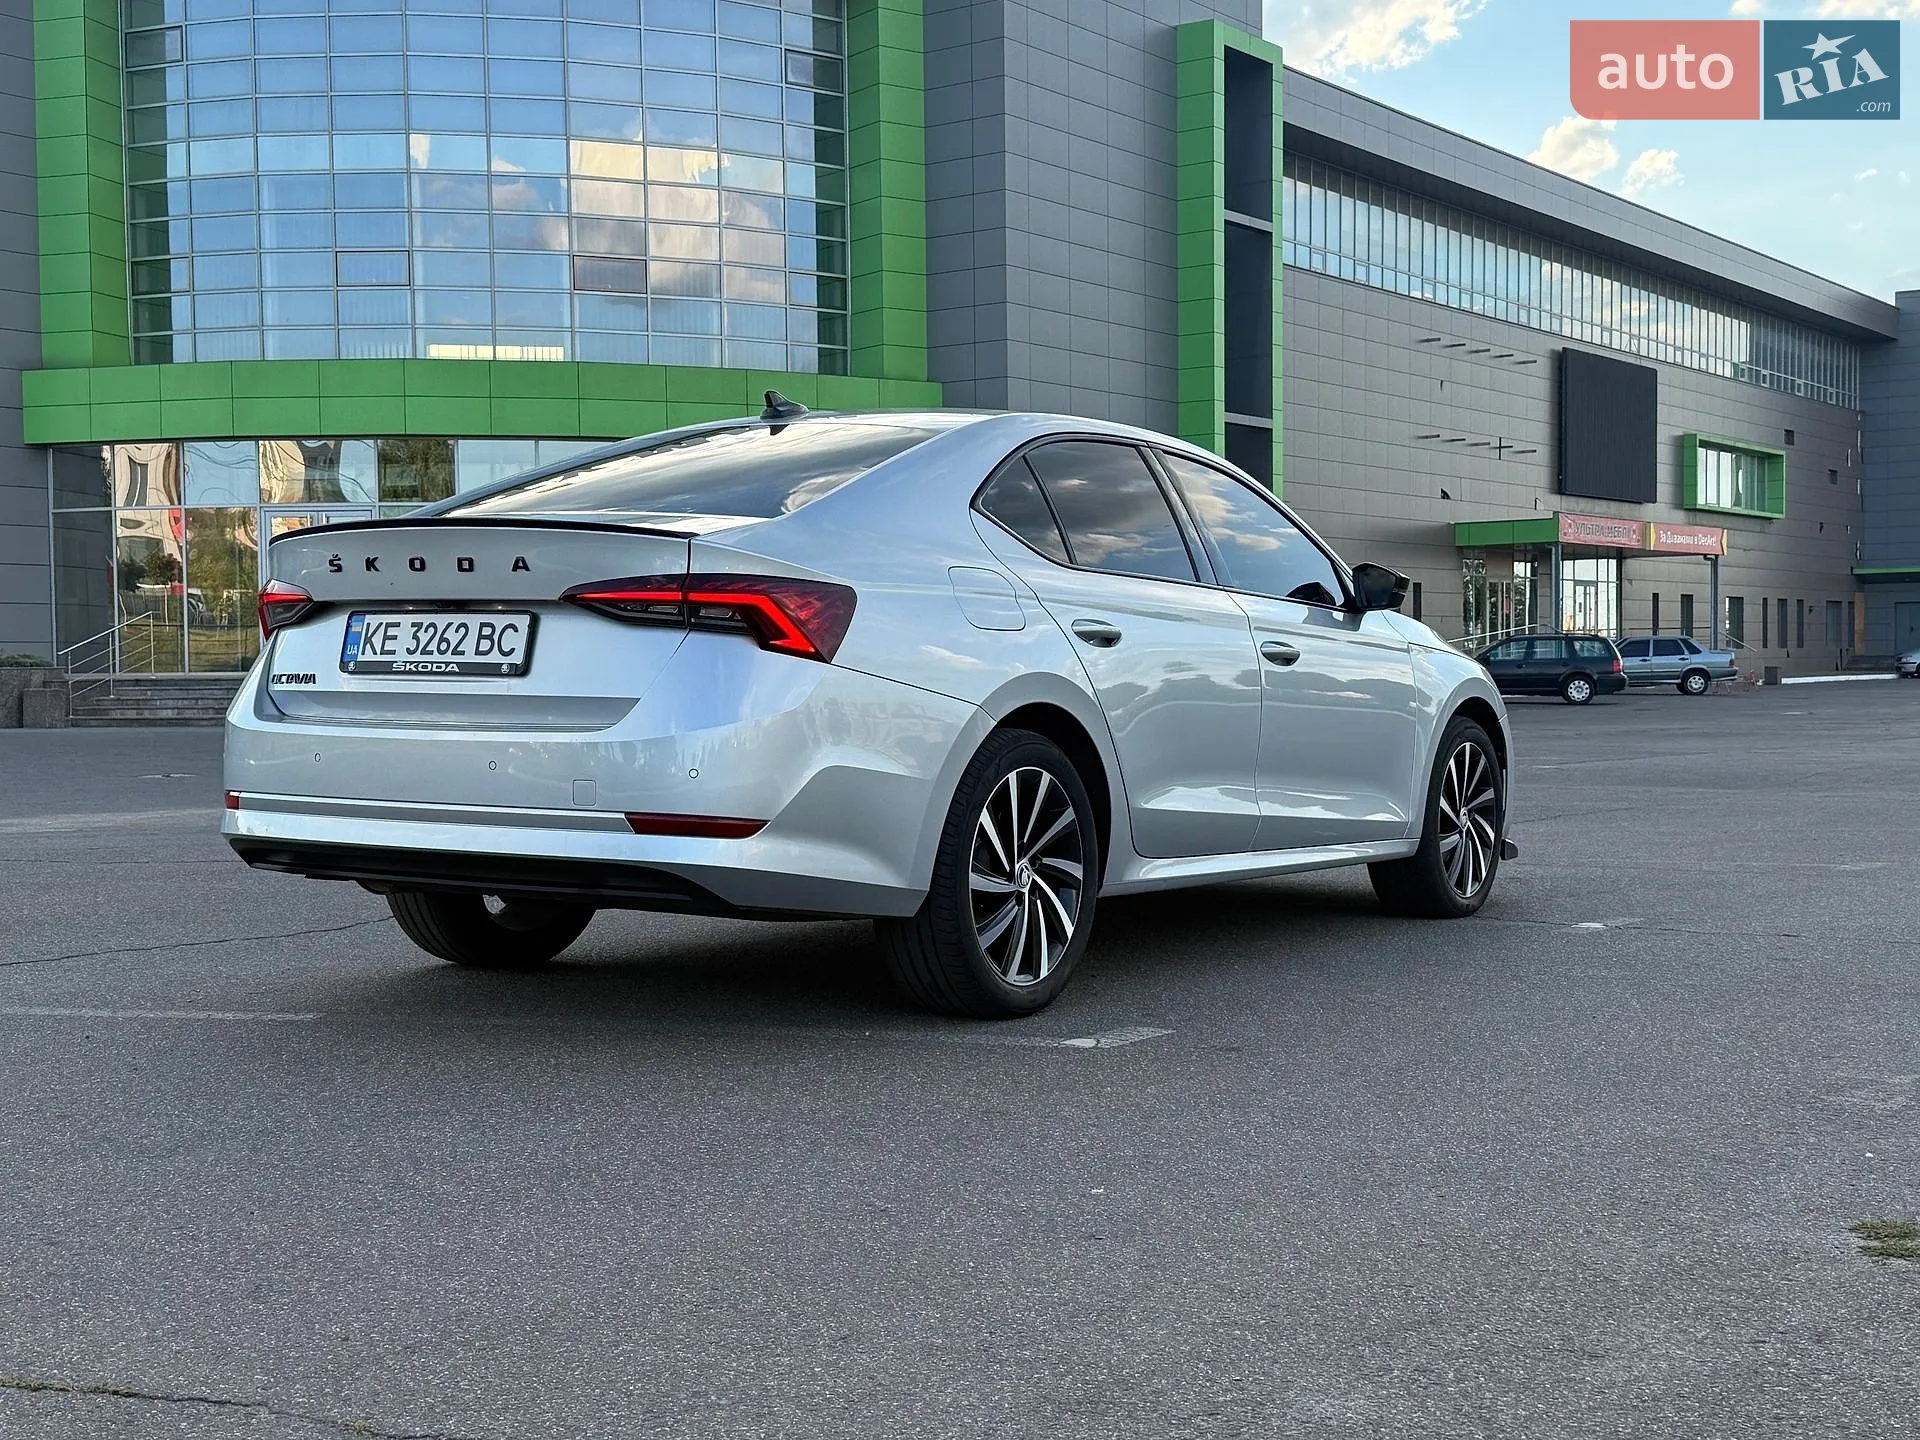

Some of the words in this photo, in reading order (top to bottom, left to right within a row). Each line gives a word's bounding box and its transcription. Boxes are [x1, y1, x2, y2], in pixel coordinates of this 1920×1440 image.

[328, 553, 531, 573] ŠKODA
[361, 621, 401, 656] KE
[405, 621, 470, 656] 3262
[474, 621, 519, 657] BC
[347, 644, 358, 656] UA
[391, 660, 460, 673] ŠKODA
